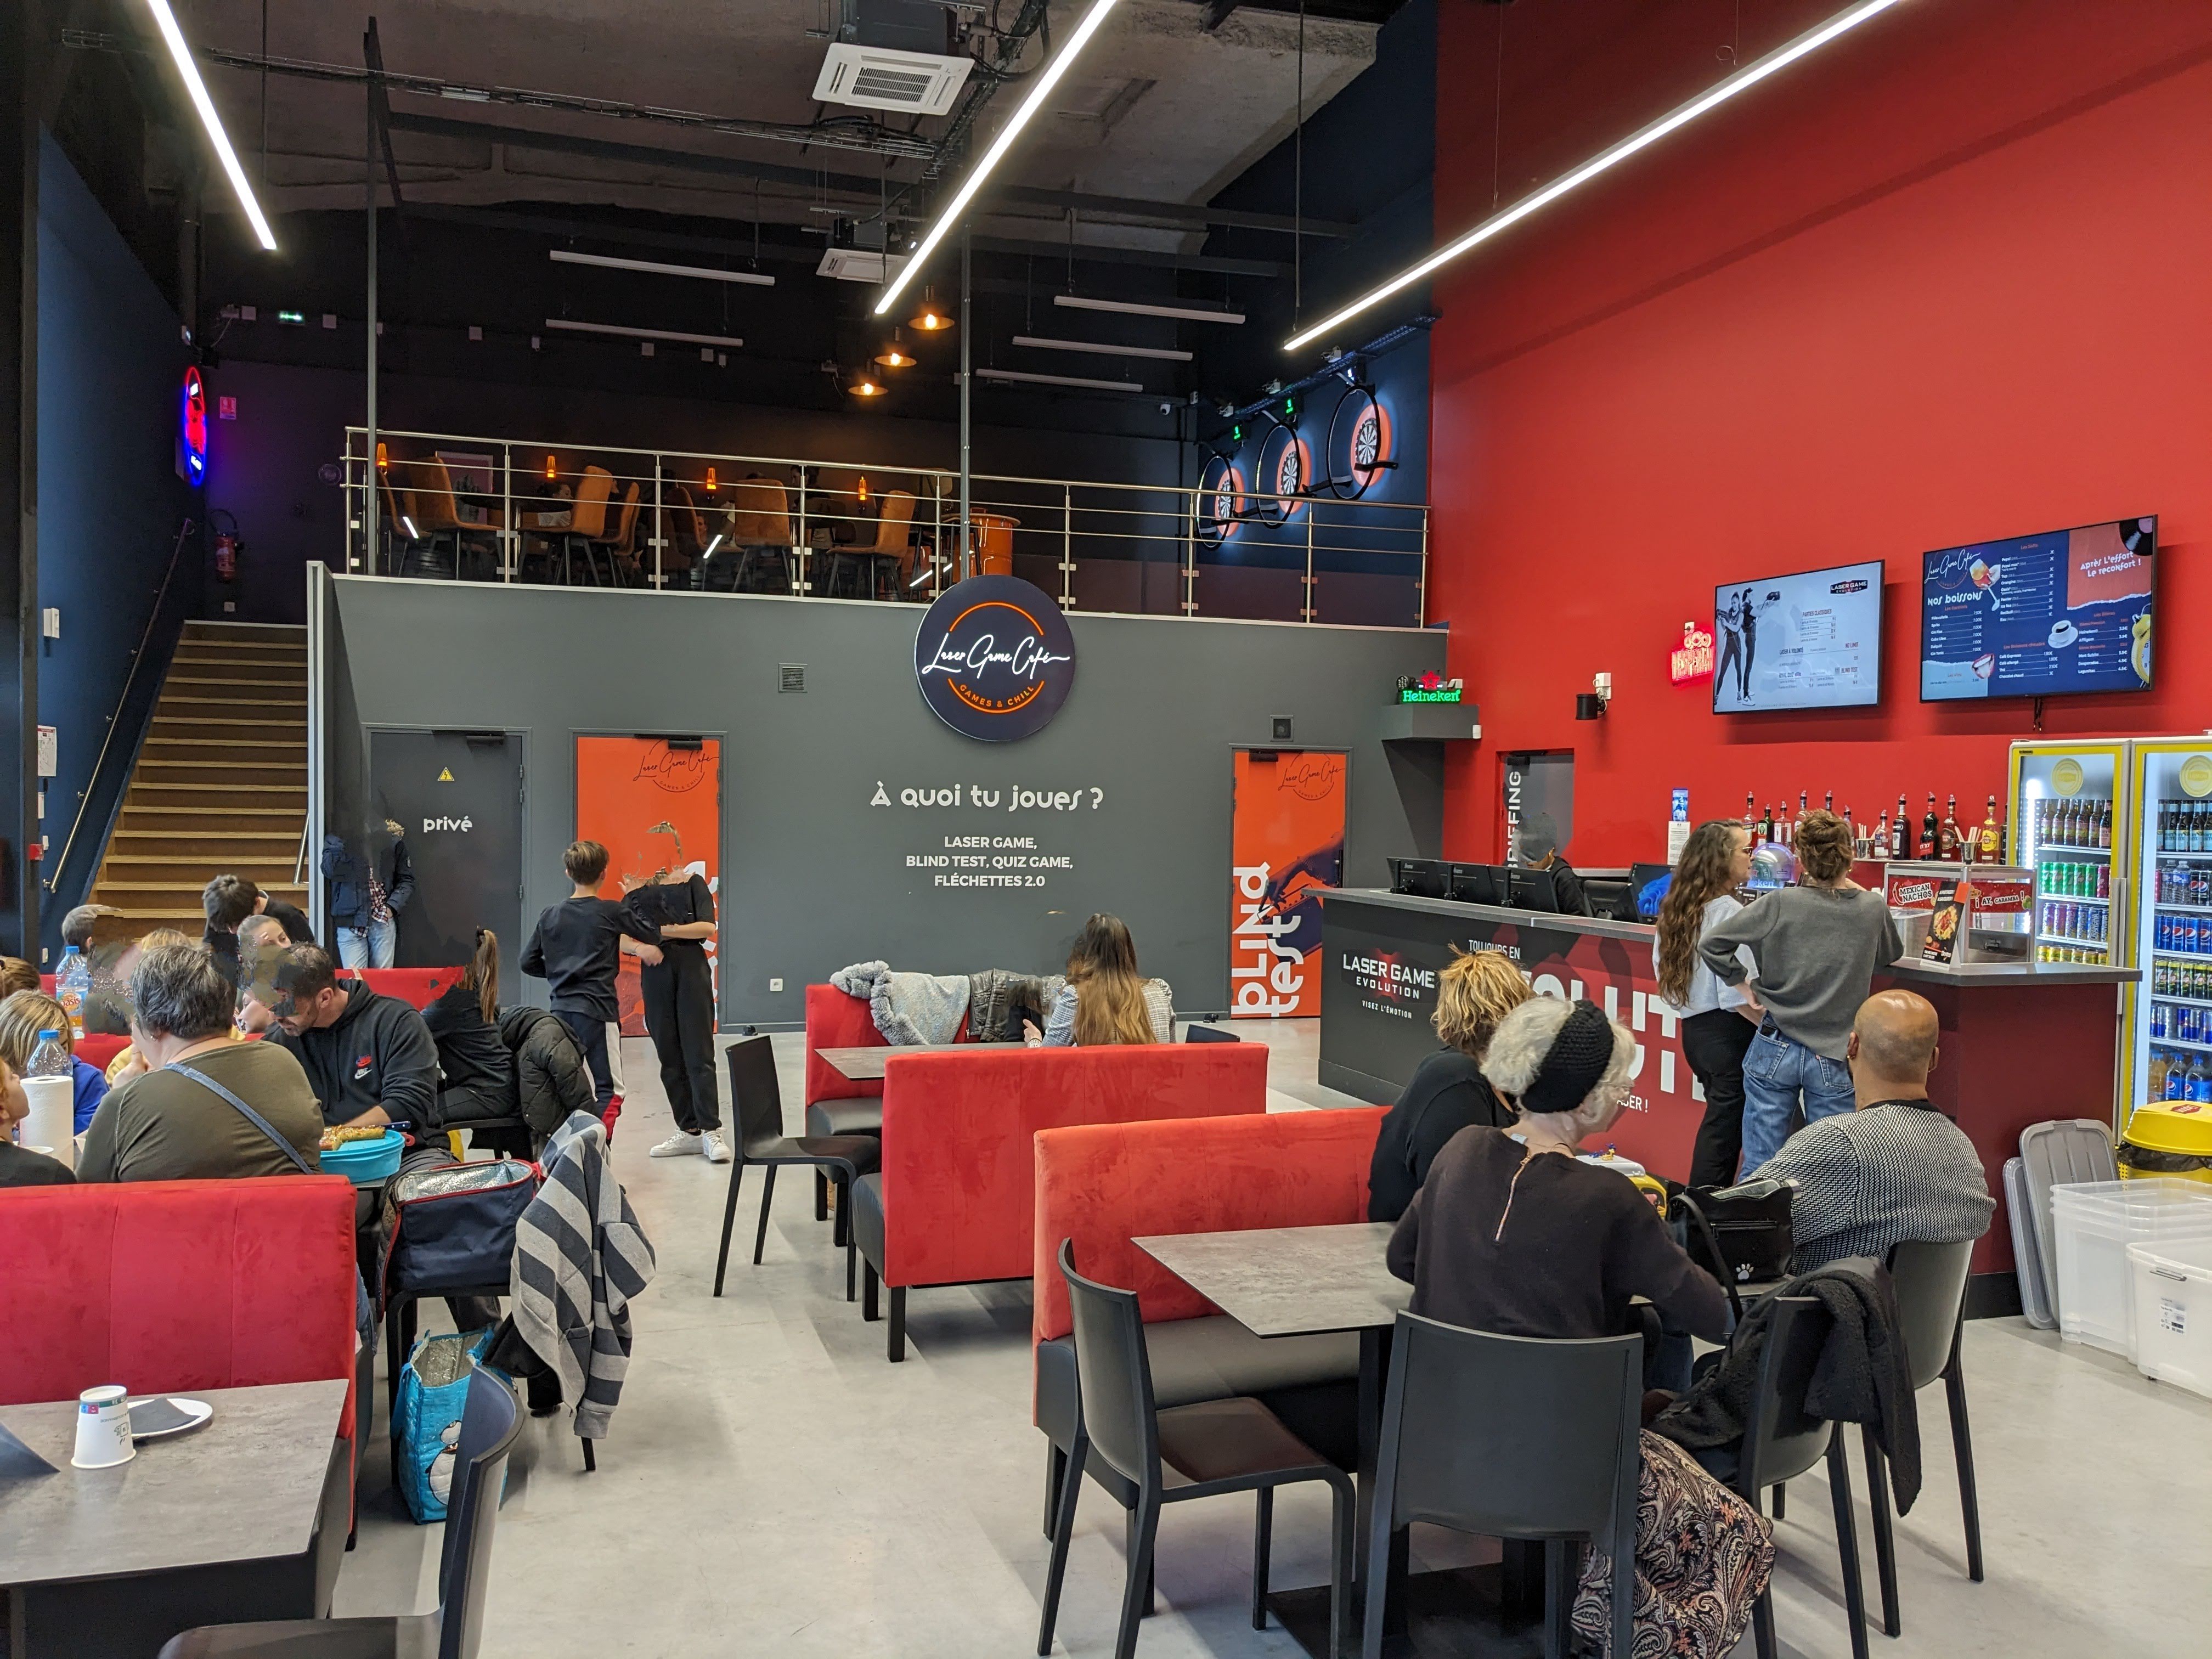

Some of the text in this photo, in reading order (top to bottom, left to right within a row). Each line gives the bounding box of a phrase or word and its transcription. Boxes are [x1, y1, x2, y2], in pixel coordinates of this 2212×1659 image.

[2080, 558, 2102, 570] Après
[922, 633, 966, 674] Laser
[967, 634, 1012, 679] Game
[960, 685, 992, 708] GAMES
[1007, 685, 1035, 706] CHILL
[1402, 689, 1460, 702] Heineken
[870, 781, 1104, 812] À quoi tu joues ?
[424, 815, 472, 833] privé
[944, 836, 1037, 850] LASER GAME,
[906, 855, 1073, 870] BLIND TEST, QUIZ GAME,
[934, 872, 1045, 887] FLÉCHETTES 2.0
[1900, 883, 1930, 896] MEXICAN
[1903, 890, 1932, 902] NACHOS
[1509, 946, 1520, 960] EN
[1343, 954, 1435, 989] LASER GAME
[1356, 977, 1419, 999] EVOLUTION
[1362, 1000, 1412, 1019] VISEZ L'ÉMOTION
